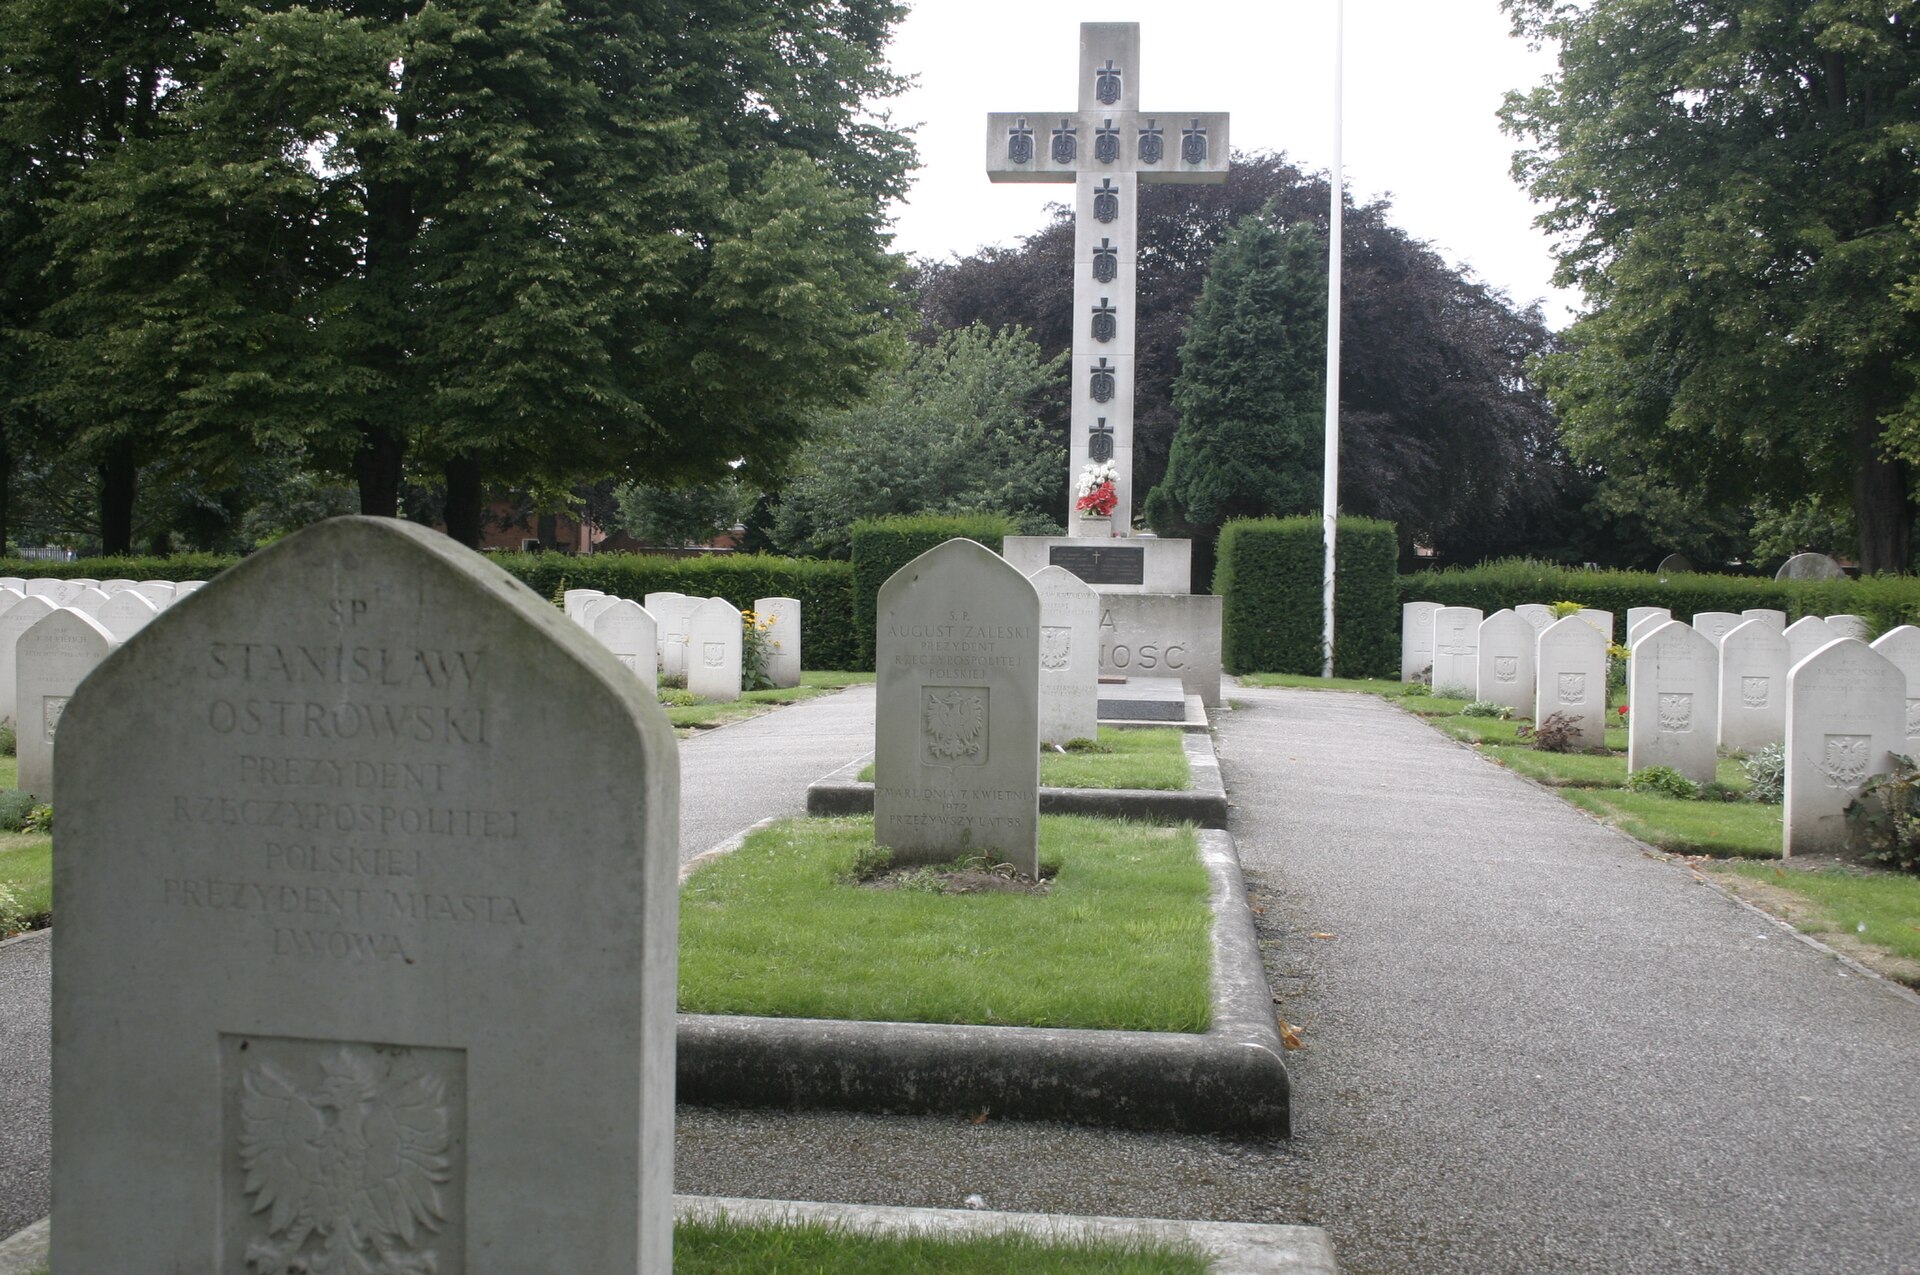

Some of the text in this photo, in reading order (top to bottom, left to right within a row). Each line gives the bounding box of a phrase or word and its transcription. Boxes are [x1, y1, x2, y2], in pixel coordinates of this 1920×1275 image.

[887, 624, 1030, 640] AUGUST ZALESKI
[920, 641, 996, 652] PREZYDENT
[206, 641, 488, 689] STANISŁAW
[895, 655, 1021, 667] RZECZYPOSPOLITEJ
[928, 668, 985, 680] POLSKIEJ
[208, 698, 492, 746] OSTROWSKI
[239, 754, 449, 792] PREZYDENT
[172, 795, 521, 839] RZECZYPOSPOLITEJ
[265, 840, 422, 877] POLSKIEJ
[162, 876, 528, 927] PREZYDENT MIASTA
[271, 925, 412, 963] LWOWA
